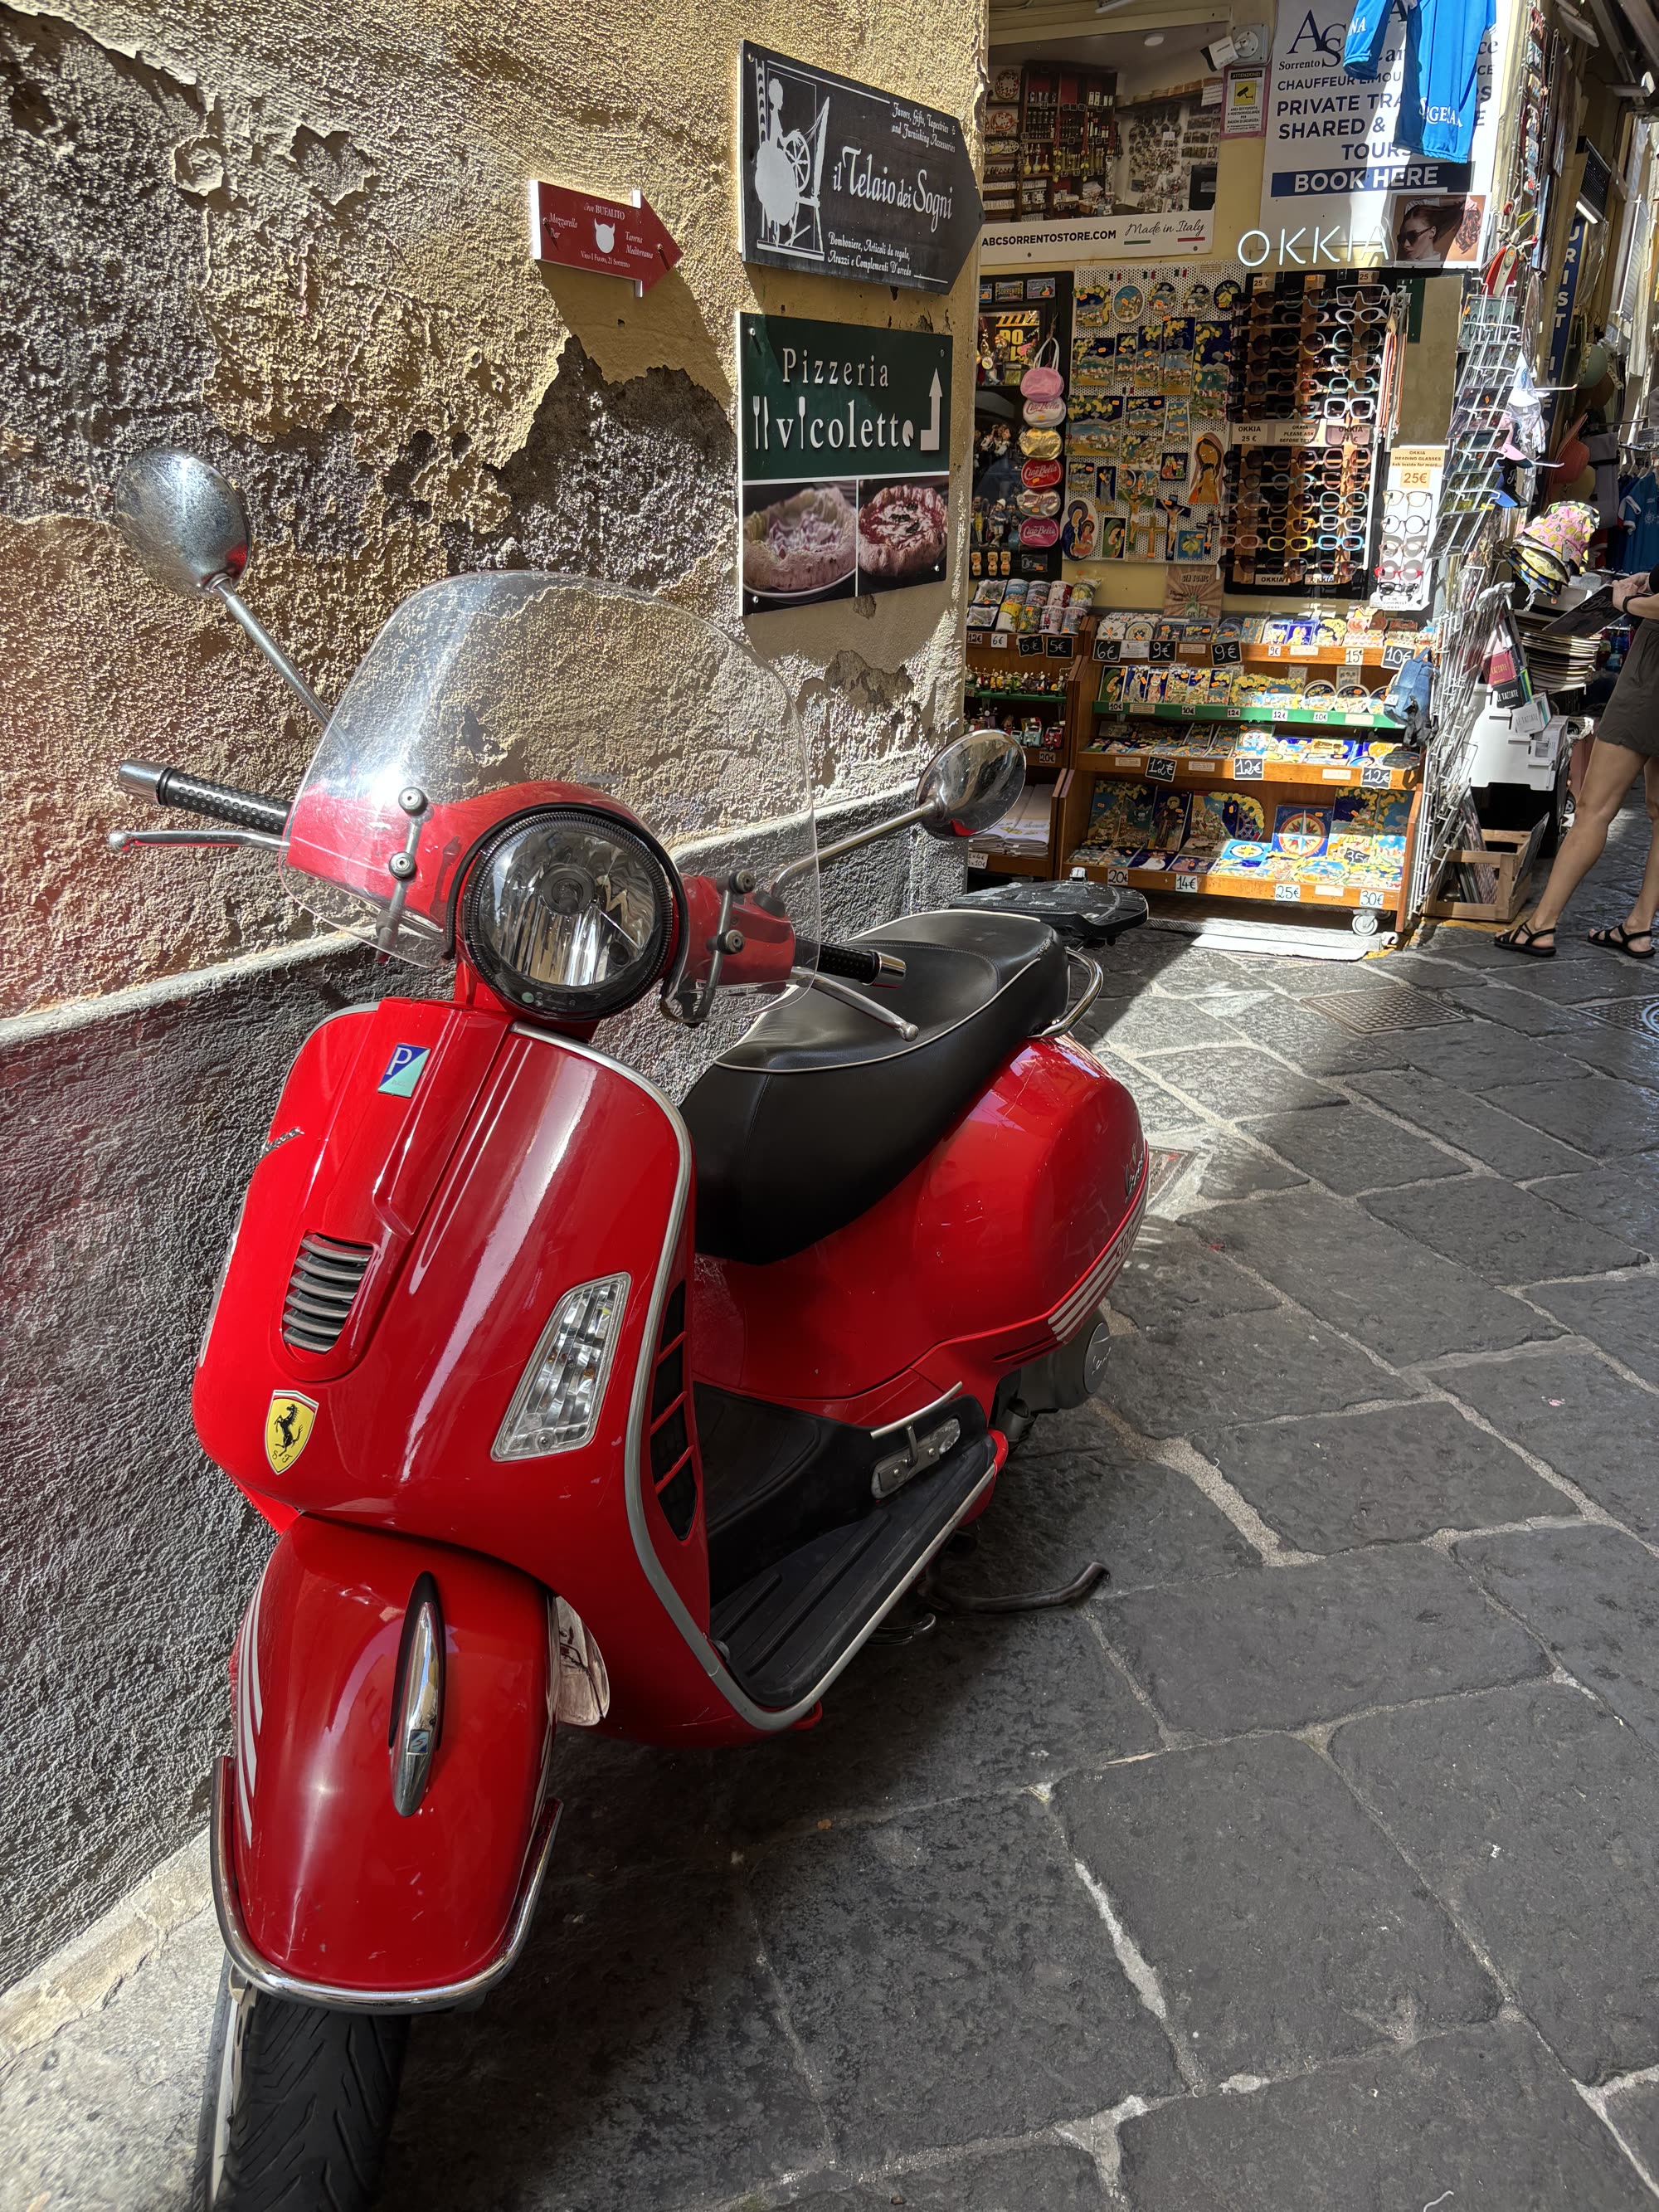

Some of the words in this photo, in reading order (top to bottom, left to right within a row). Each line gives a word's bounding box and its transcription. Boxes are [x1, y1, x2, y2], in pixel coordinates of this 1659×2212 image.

[1278, 59, 1321, 71] Sorrento
[1277, 76, 1355, 91] CHAUFFEUR
[1277, 95, 1360, 117] PRIVATE
[892, 122, 902, 135] and
[1278, 118, 1365, 140] SHARED
[1372, 116, 1385, 133] &
[1294, 170, 1365, 193] BOOK
[1373, 165, 1439, 189] HERE
[833, 161, 842, 192] il
[842, 145, 896, 205] Telaio
[897, 178, 912, 209] dei
[913, 168, 953, 233] Sogni
[595, 204, 625, 221] BUFALITO
[1125, 221, 1161, 236] Made
[1162, 224, 1174, 233] in
[1175, 219, 1206, 237] Italy
[828, 231, 863, 252] Bomboniere,
[864, 239, 887, 256] Articoli
[981, 229, 1117, 246] ABCSORRENTOSTORE.COM
[1237, 225, 1390, 267] OKKIA
[828, 250, 850, 266] Arazzi
[855, 256, 889, 274] Complementi
[1554, 225, 1581, 329] URIST
[782, 347, 890, 388] Pizzeria
[1403, 472, 1428, 485] 25€
[992, 636, 1003, 646] 6€
[1048, 640, 1067, 653] 5€
[1097, 641, 1118, 660] 6€
[1152, 641, 1171, 659] 9€
[1214, 644, 1238, 661] 9€
[1039, 753, 1055, 763] 20€
[1235, 758, 1262, 775] 12€
[1149, 758, 1175, 776] 12€
[1363, 770, 1391, 784] 12€
[1108, 869, 1128, 884] 20€
[1176, 875, 1197, 890] 14€
[1275, 884, 1301, 899] 25€
[1361, 889, 1384, 906] 30€
[386, 1047, 412, 1075] P
[271, 1449, 279, 1460] S
